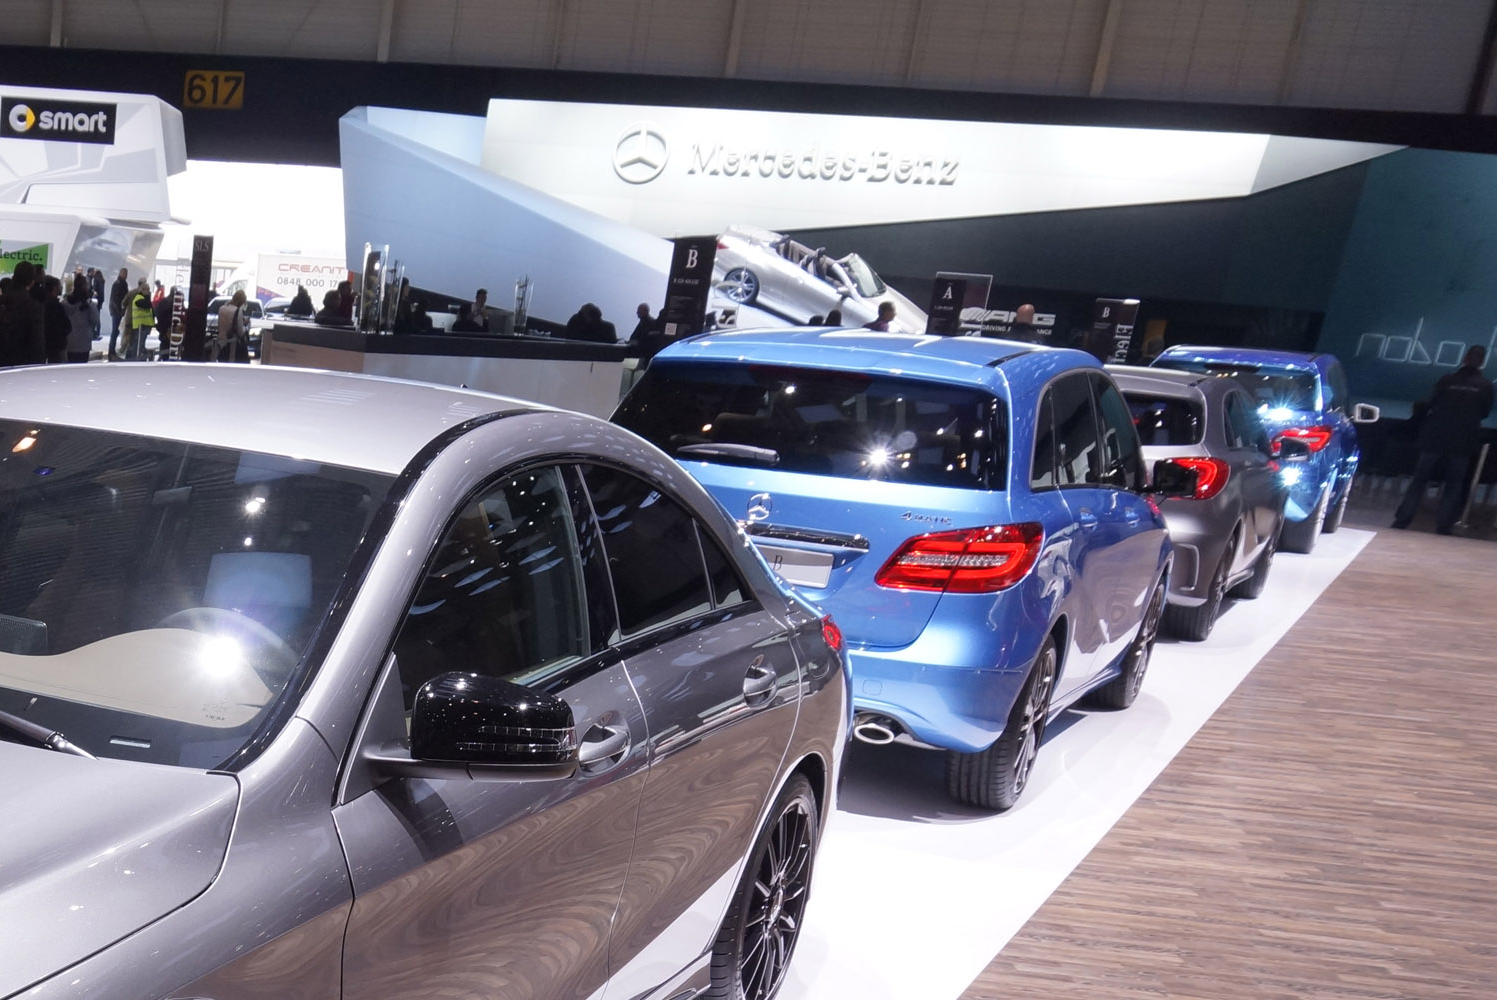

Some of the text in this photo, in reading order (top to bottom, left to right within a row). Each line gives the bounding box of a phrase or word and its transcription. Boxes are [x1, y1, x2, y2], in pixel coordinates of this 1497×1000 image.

[187, 73, 244, 106] 617
[38, 110, 108, 133] smart
[687, 142, 960, 186] Mercedes-Benz
[685, 249, 698, 268] B
[943, 286, 953, 299] A
[772, 554, 783, 571] B
